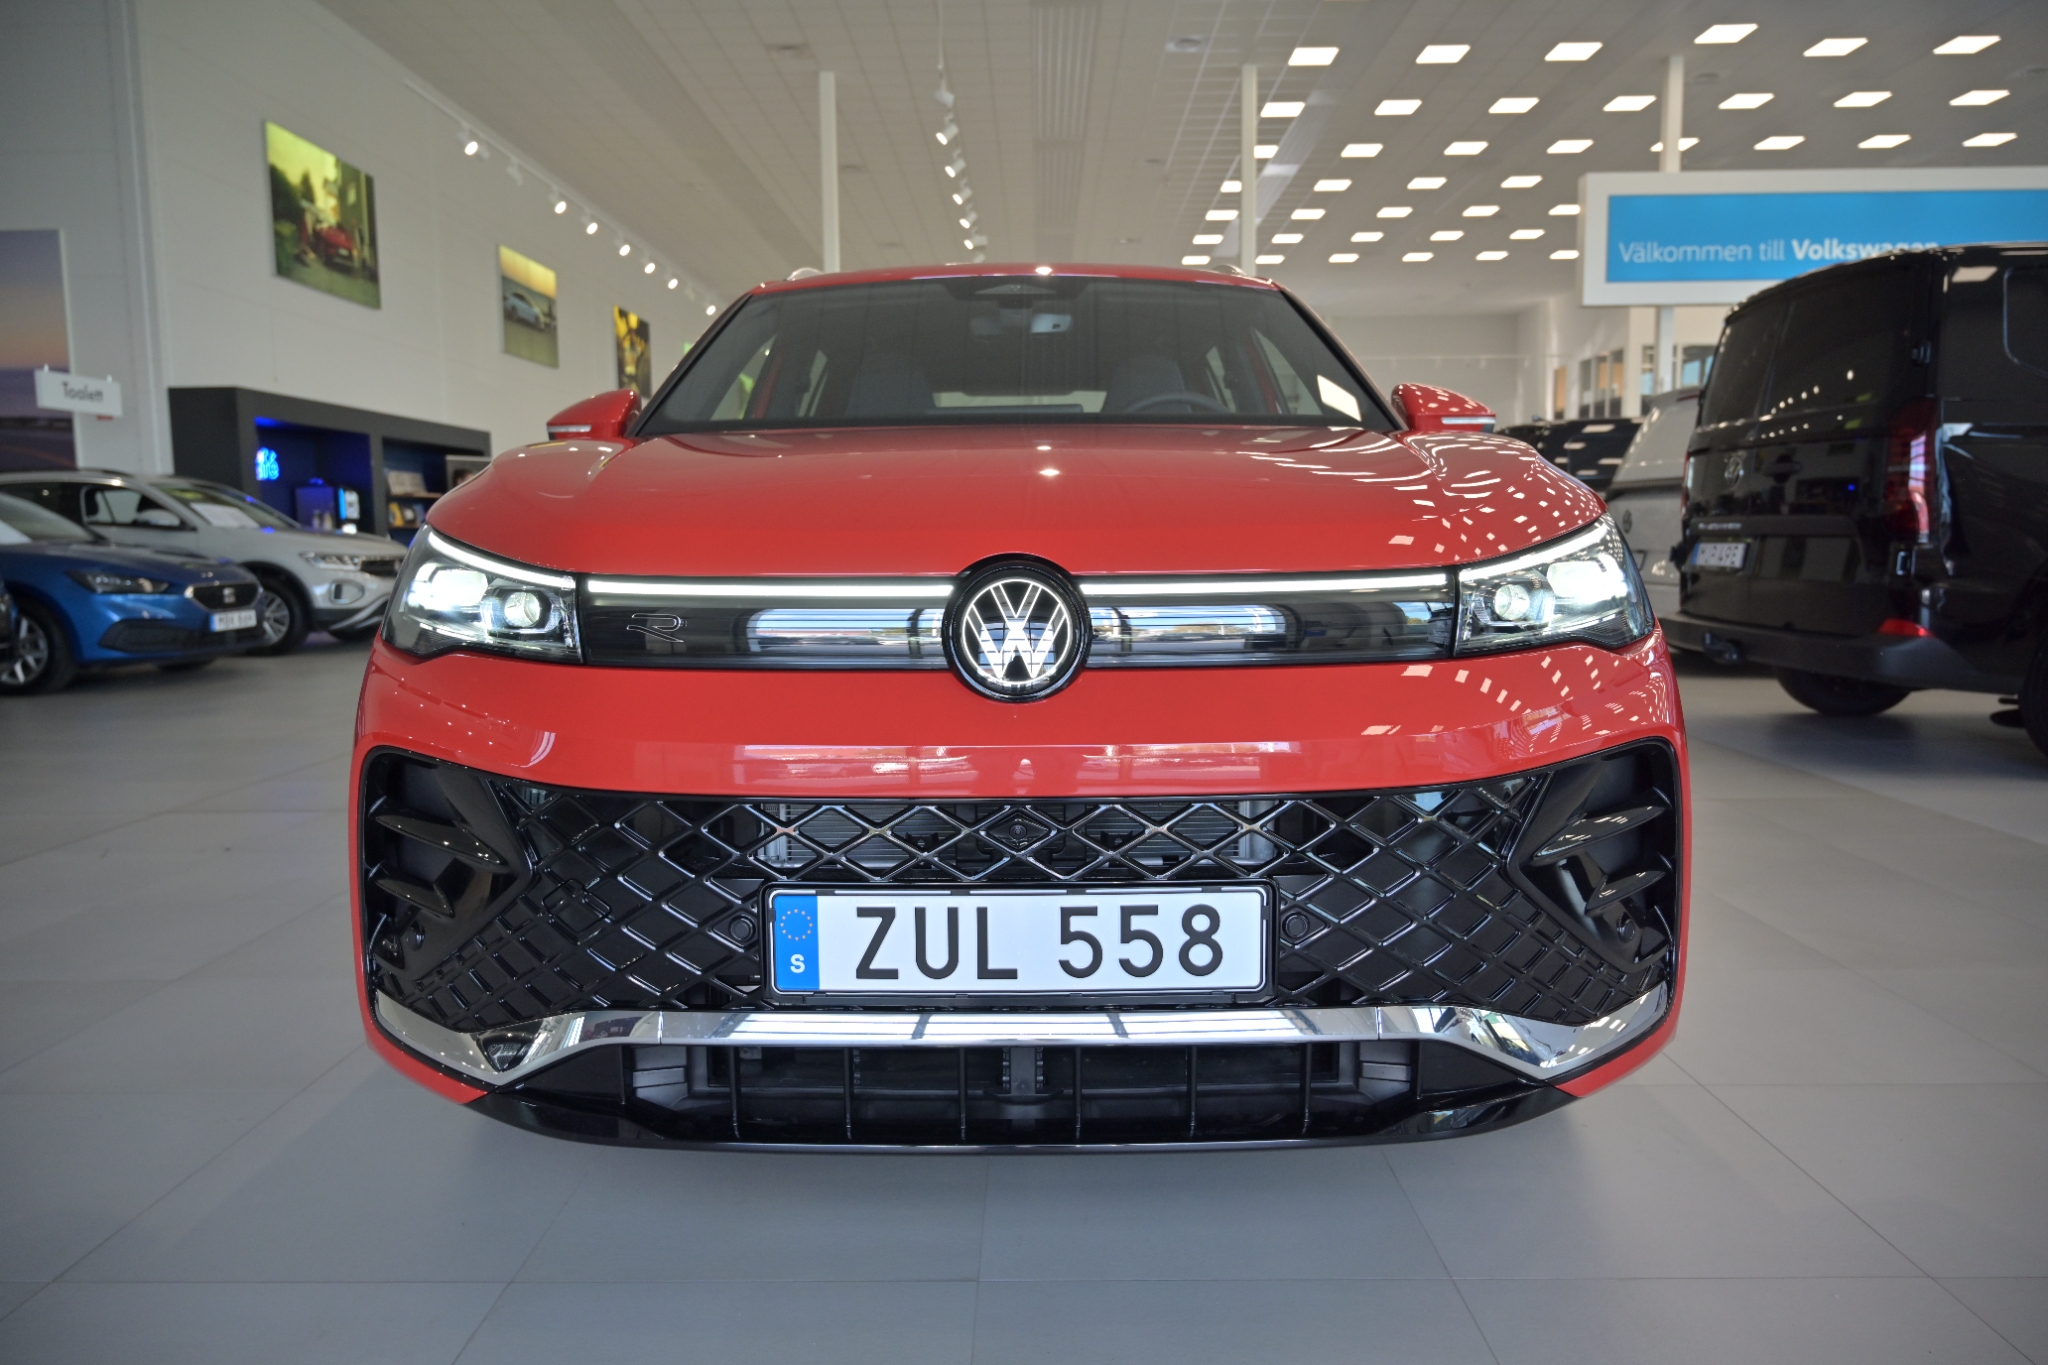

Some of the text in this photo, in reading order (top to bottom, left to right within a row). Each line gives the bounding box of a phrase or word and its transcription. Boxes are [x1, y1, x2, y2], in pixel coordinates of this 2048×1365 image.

[1618, 240, 1752, 263] Välkommen
[1759, 238, 1785, 262] till
[855, 903, 1224, 980] ZUL 558
[790, 953, 806, 974] S
